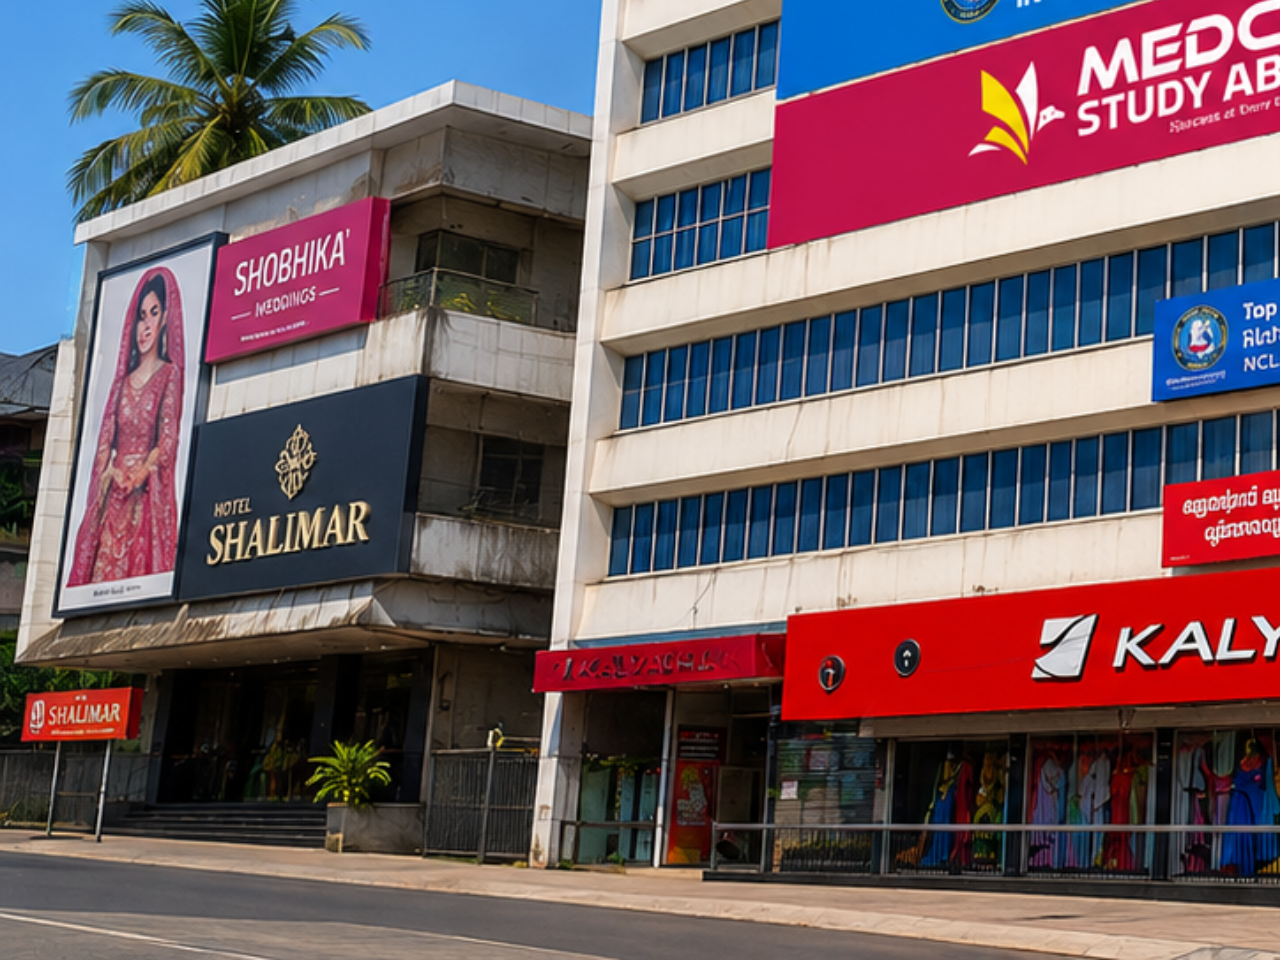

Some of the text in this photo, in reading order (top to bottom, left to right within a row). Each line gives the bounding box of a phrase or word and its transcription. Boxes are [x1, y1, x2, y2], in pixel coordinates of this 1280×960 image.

[1078, 70, 1212, 137] STUDY
[1242, 301, 1278, 322] Top
[213, 497, 252, 518] HOTEL
[206, 500, 372, 566] SHALIMAR
